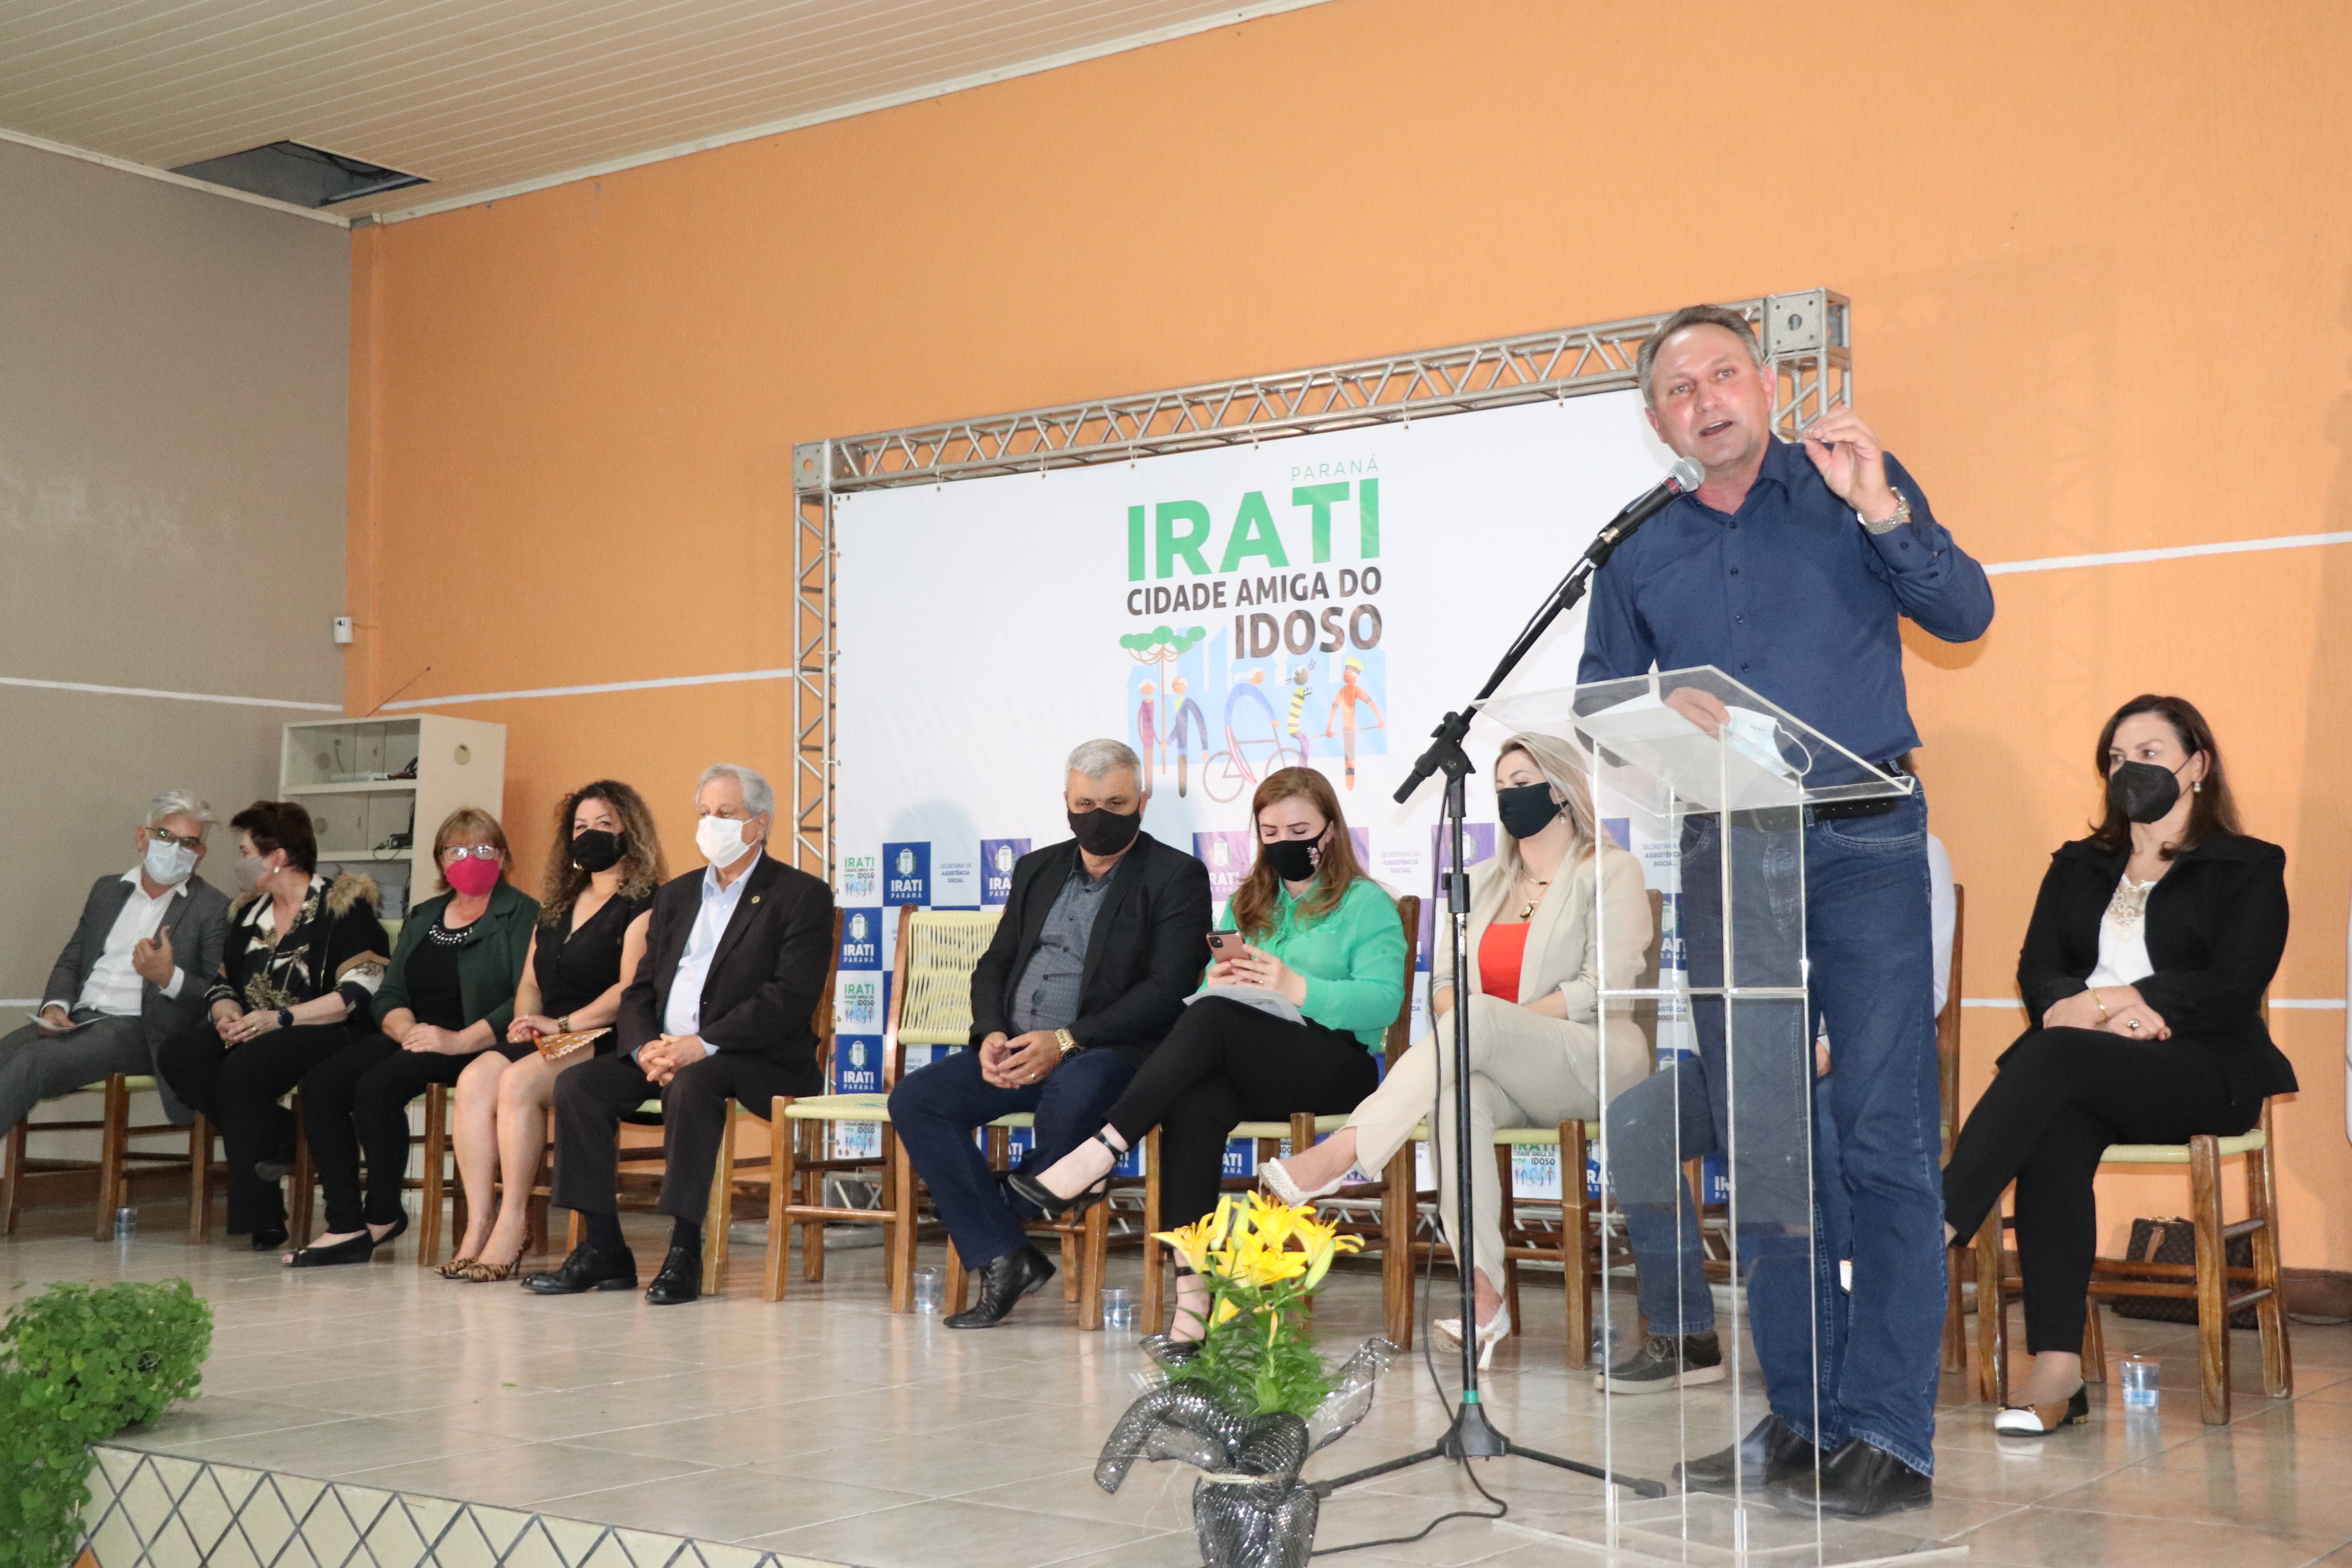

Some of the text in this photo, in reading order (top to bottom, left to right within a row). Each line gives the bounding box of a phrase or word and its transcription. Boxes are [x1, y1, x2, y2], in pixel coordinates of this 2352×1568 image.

[1291, 454, 1378, 481] PARANÁ
[1128, 477, 1380, 582] IRATI
[1127, 566, 1381, 616] CIDADE AMIGA DO
[1235, 603, 1382, 659] IDOSO
[845, 857, 875, 867] IRATI
[989, 877, 1012, 890] IRA
[1209, 872, 1240, 885] RATI
[891, 879, 922, 892] IRATI
[843, 944, 874, 956] IRATI
[844, 983, 874, 994] IRATI
[843, 1070, 874, 1084] IRATI
[1223, 1152, 1242, 1167] ATI
[1531, 1157, 1555, 1166] IDOSO
